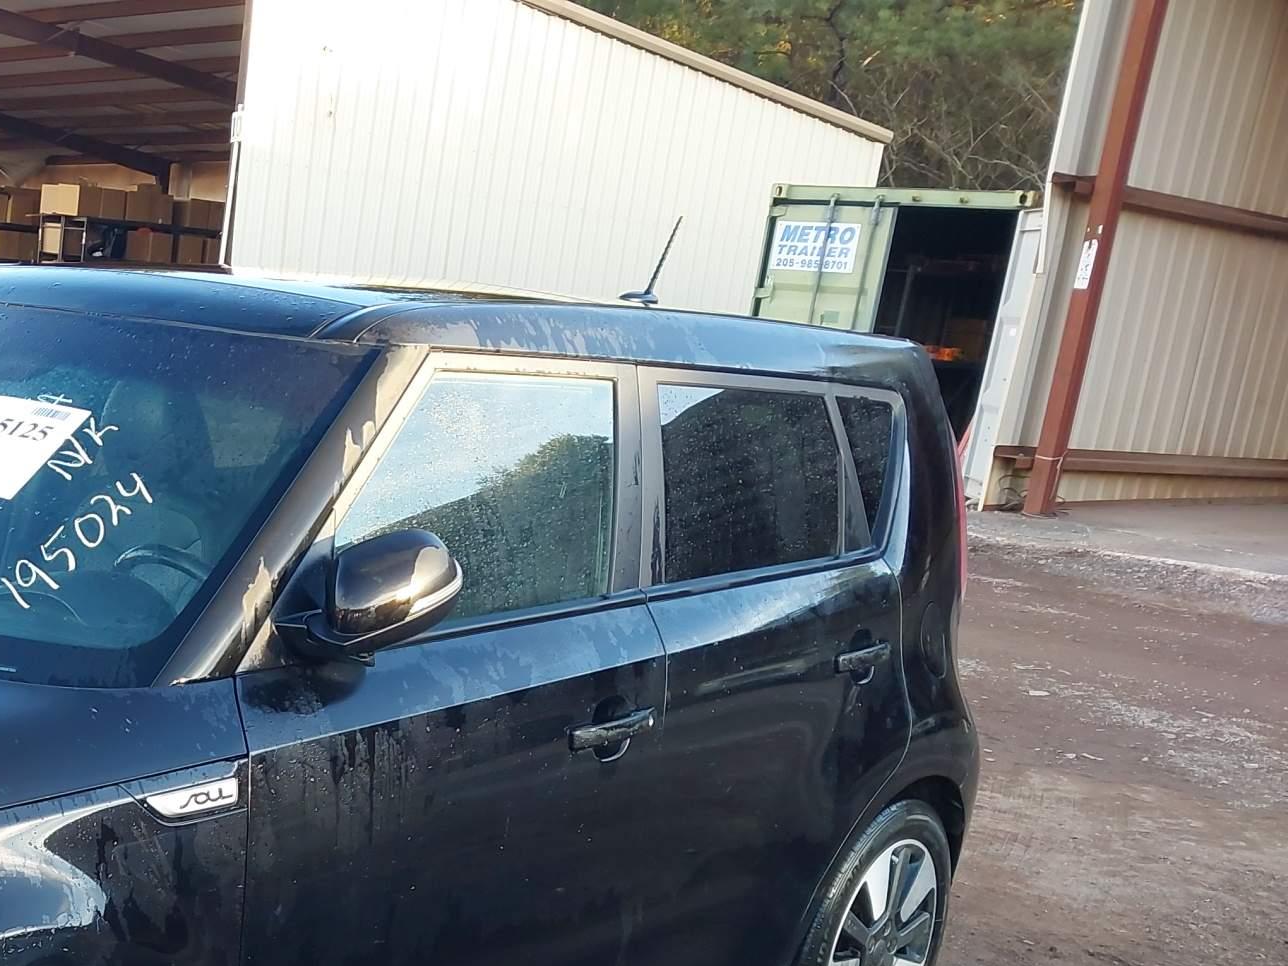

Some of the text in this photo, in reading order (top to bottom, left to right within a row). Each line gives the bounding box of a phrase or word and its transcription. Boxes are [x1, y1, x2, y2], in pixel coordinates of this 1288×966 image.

[780, 225, 856, 245] METRO
[777, 244, 851, 258] TRAILER
[775, 258, 849, 270] 205-9858701
[1, 473, 154, 609] 195024
[179, 787, 234, 809] SOUL
